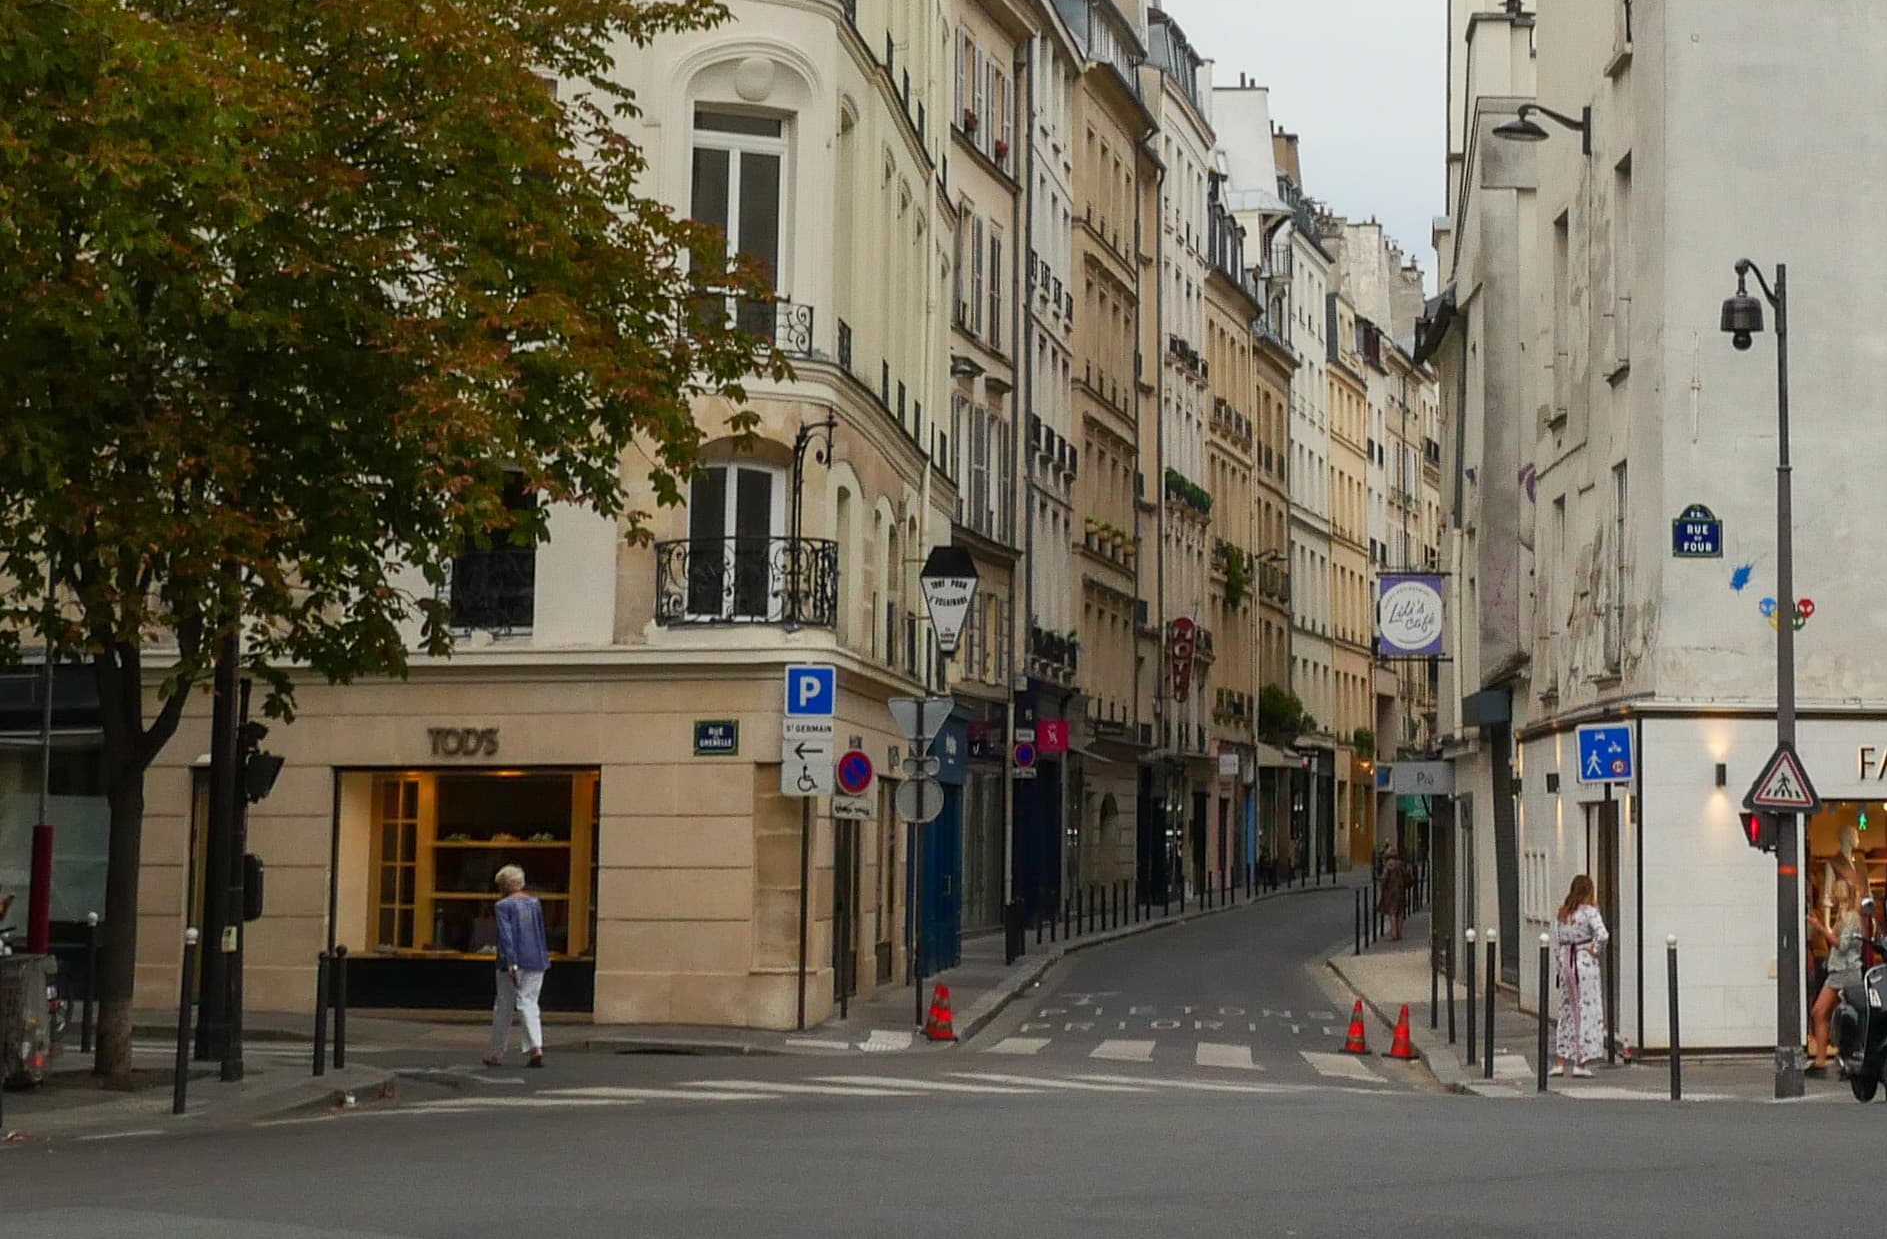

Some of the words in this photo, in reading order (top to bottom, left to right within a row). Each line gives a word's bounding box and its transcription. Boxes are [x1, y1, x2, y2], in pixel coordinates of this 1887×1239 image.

[1686, 524, 1709, 535] RUE
[1683, 542, 1712, 552] FOUR
[799, 675, 821, 707] P
[795, 725, 832, 733] GERMAIN
